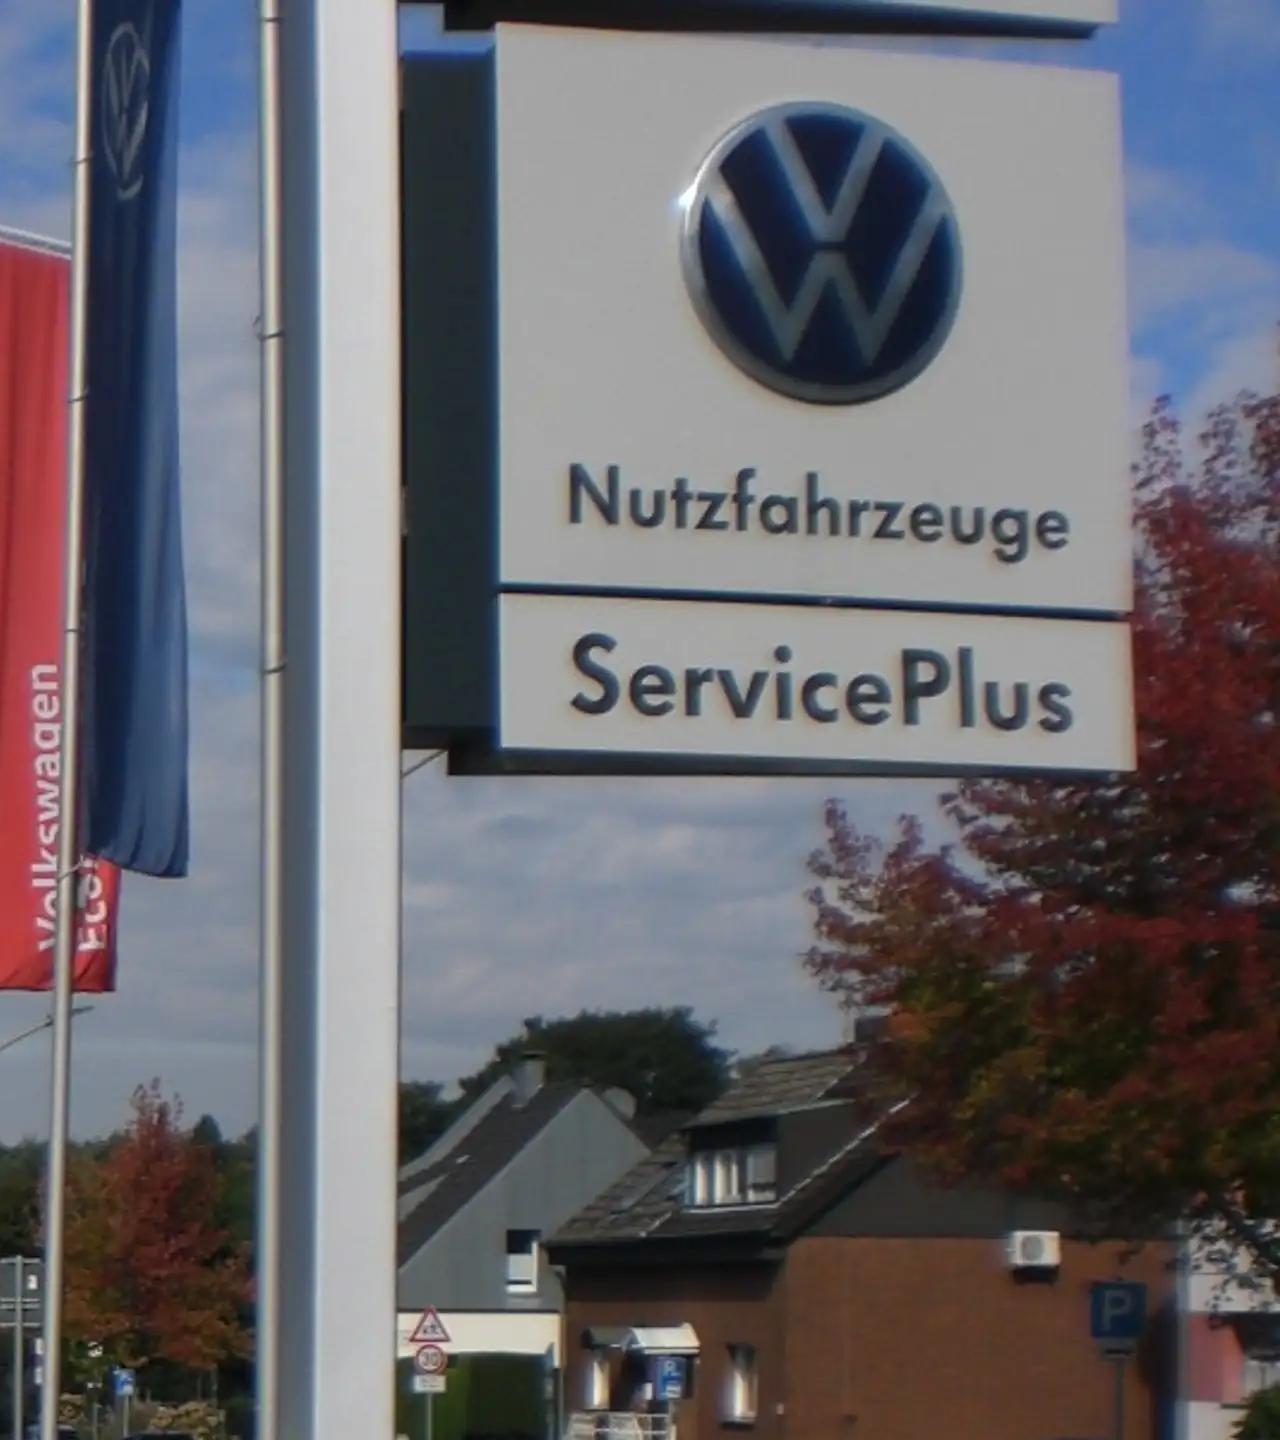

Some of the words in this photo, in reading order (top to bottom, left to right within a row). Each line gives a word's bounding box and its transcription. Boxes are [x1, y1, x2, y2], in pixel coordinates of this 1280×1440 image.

[568, 463, 1070, 565] Nutzfahrzeuge
[570, 632, 1074, 733] ServicePlus
[1102, 1289, 1132, 1333] P
